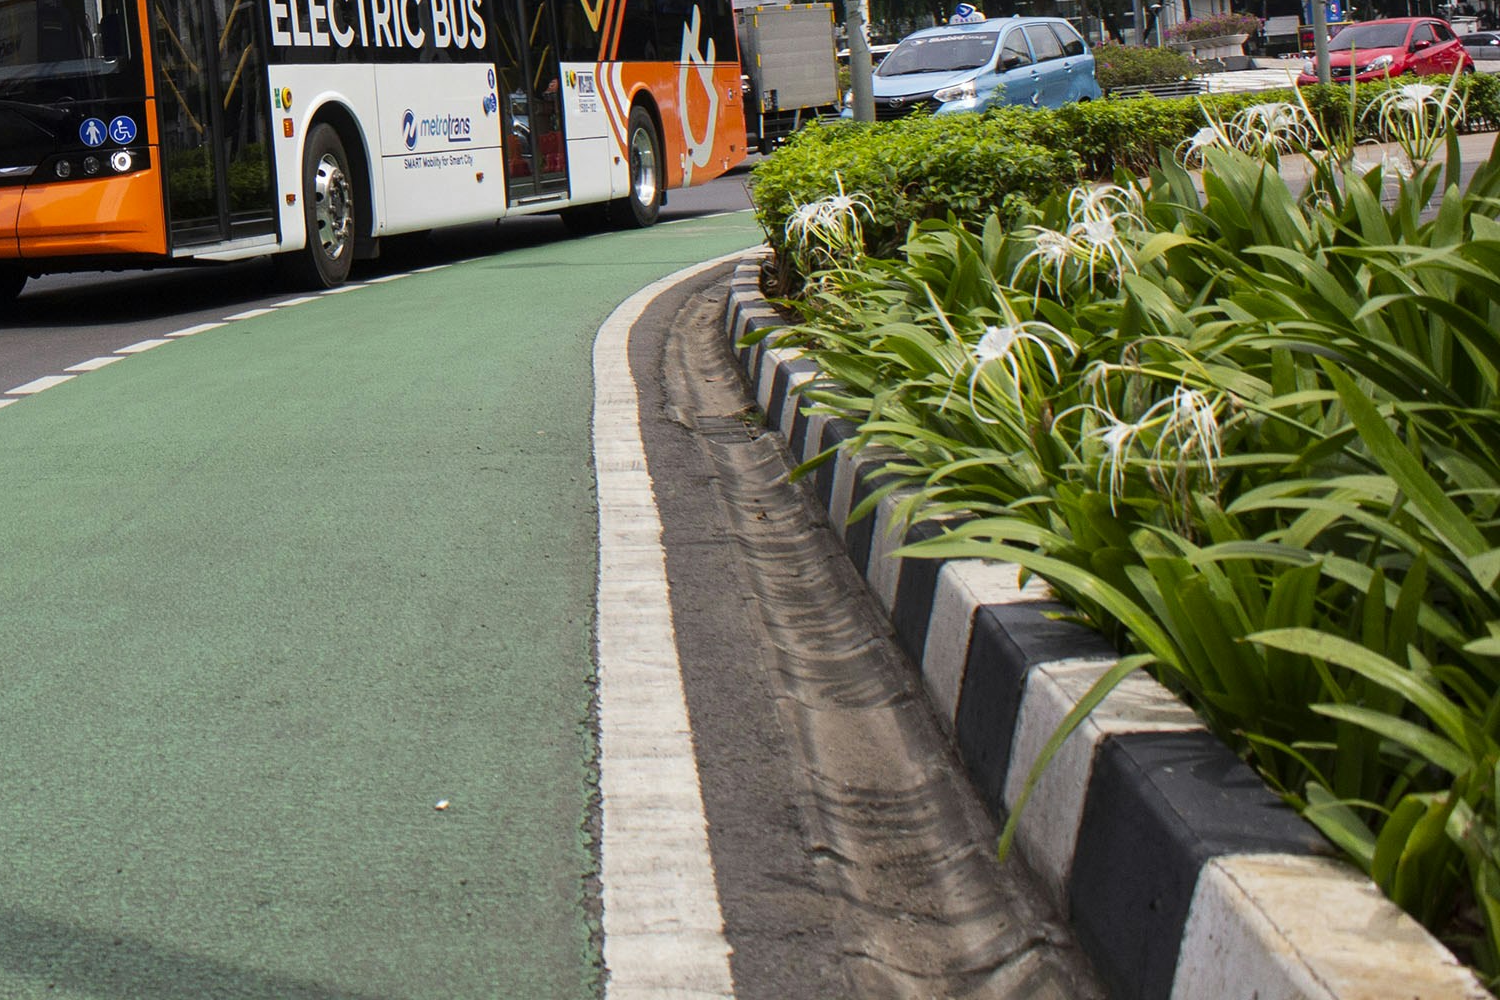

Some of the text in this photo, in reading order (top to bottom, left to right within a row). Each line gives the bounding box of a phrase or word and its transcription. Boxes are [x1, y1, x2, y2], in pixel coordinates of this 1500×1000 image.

[420, 113, 471, 142] metrotrans
[404, 157, 421, 169] SMART
[423, 155, 441, 169] Mobility
[450, 154, 463, 165] Smart
[464, 154, 473, 167] City
